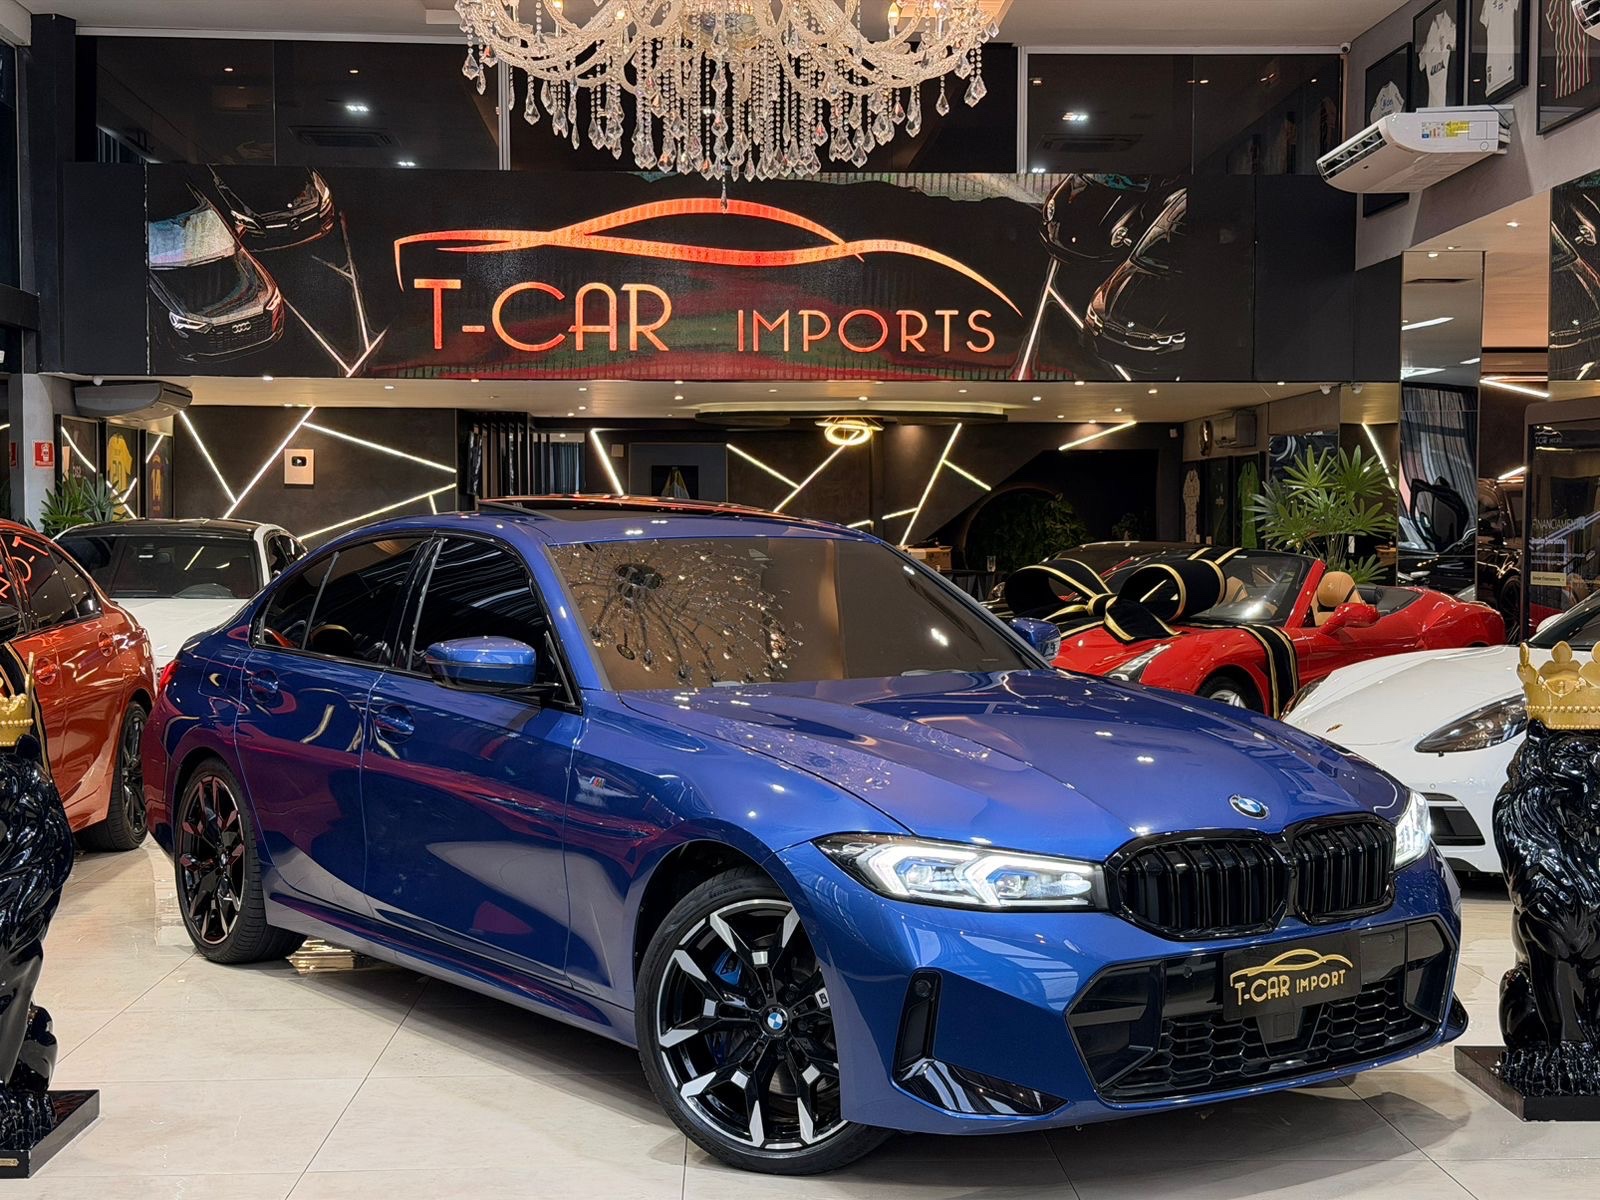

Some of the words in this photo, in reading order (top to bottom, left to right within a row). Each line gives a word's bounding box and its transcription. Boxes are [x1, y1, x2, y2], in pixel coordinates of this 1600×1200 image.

[413, 278, 672, 351] T-CAR
[737, 309, 996, 353] IMPORTS
[1296, 969, 1346, 993] IMPORT
